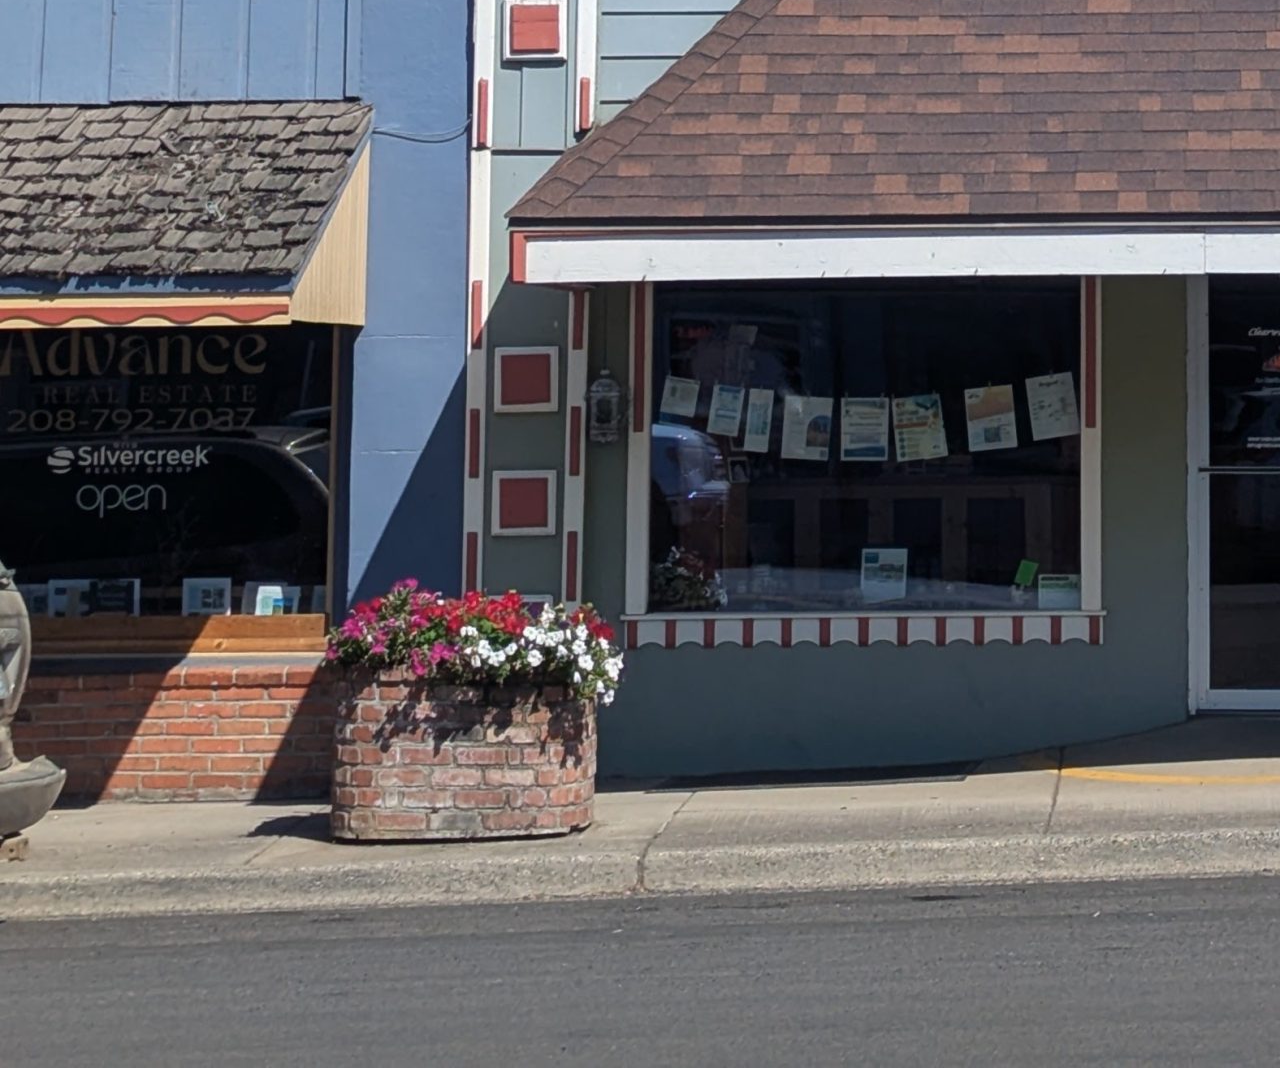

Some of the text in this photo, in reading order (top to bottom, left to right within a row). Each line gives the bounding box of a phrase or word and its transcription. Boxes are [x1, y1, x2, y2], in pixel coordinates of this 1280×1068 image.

[0, 330, 268, 376] Advance
[44, 384, 257, 404] REAL ESTATE
[78, 444, 210, 468] Silvercreek
[76, 484, 167, 518] open
